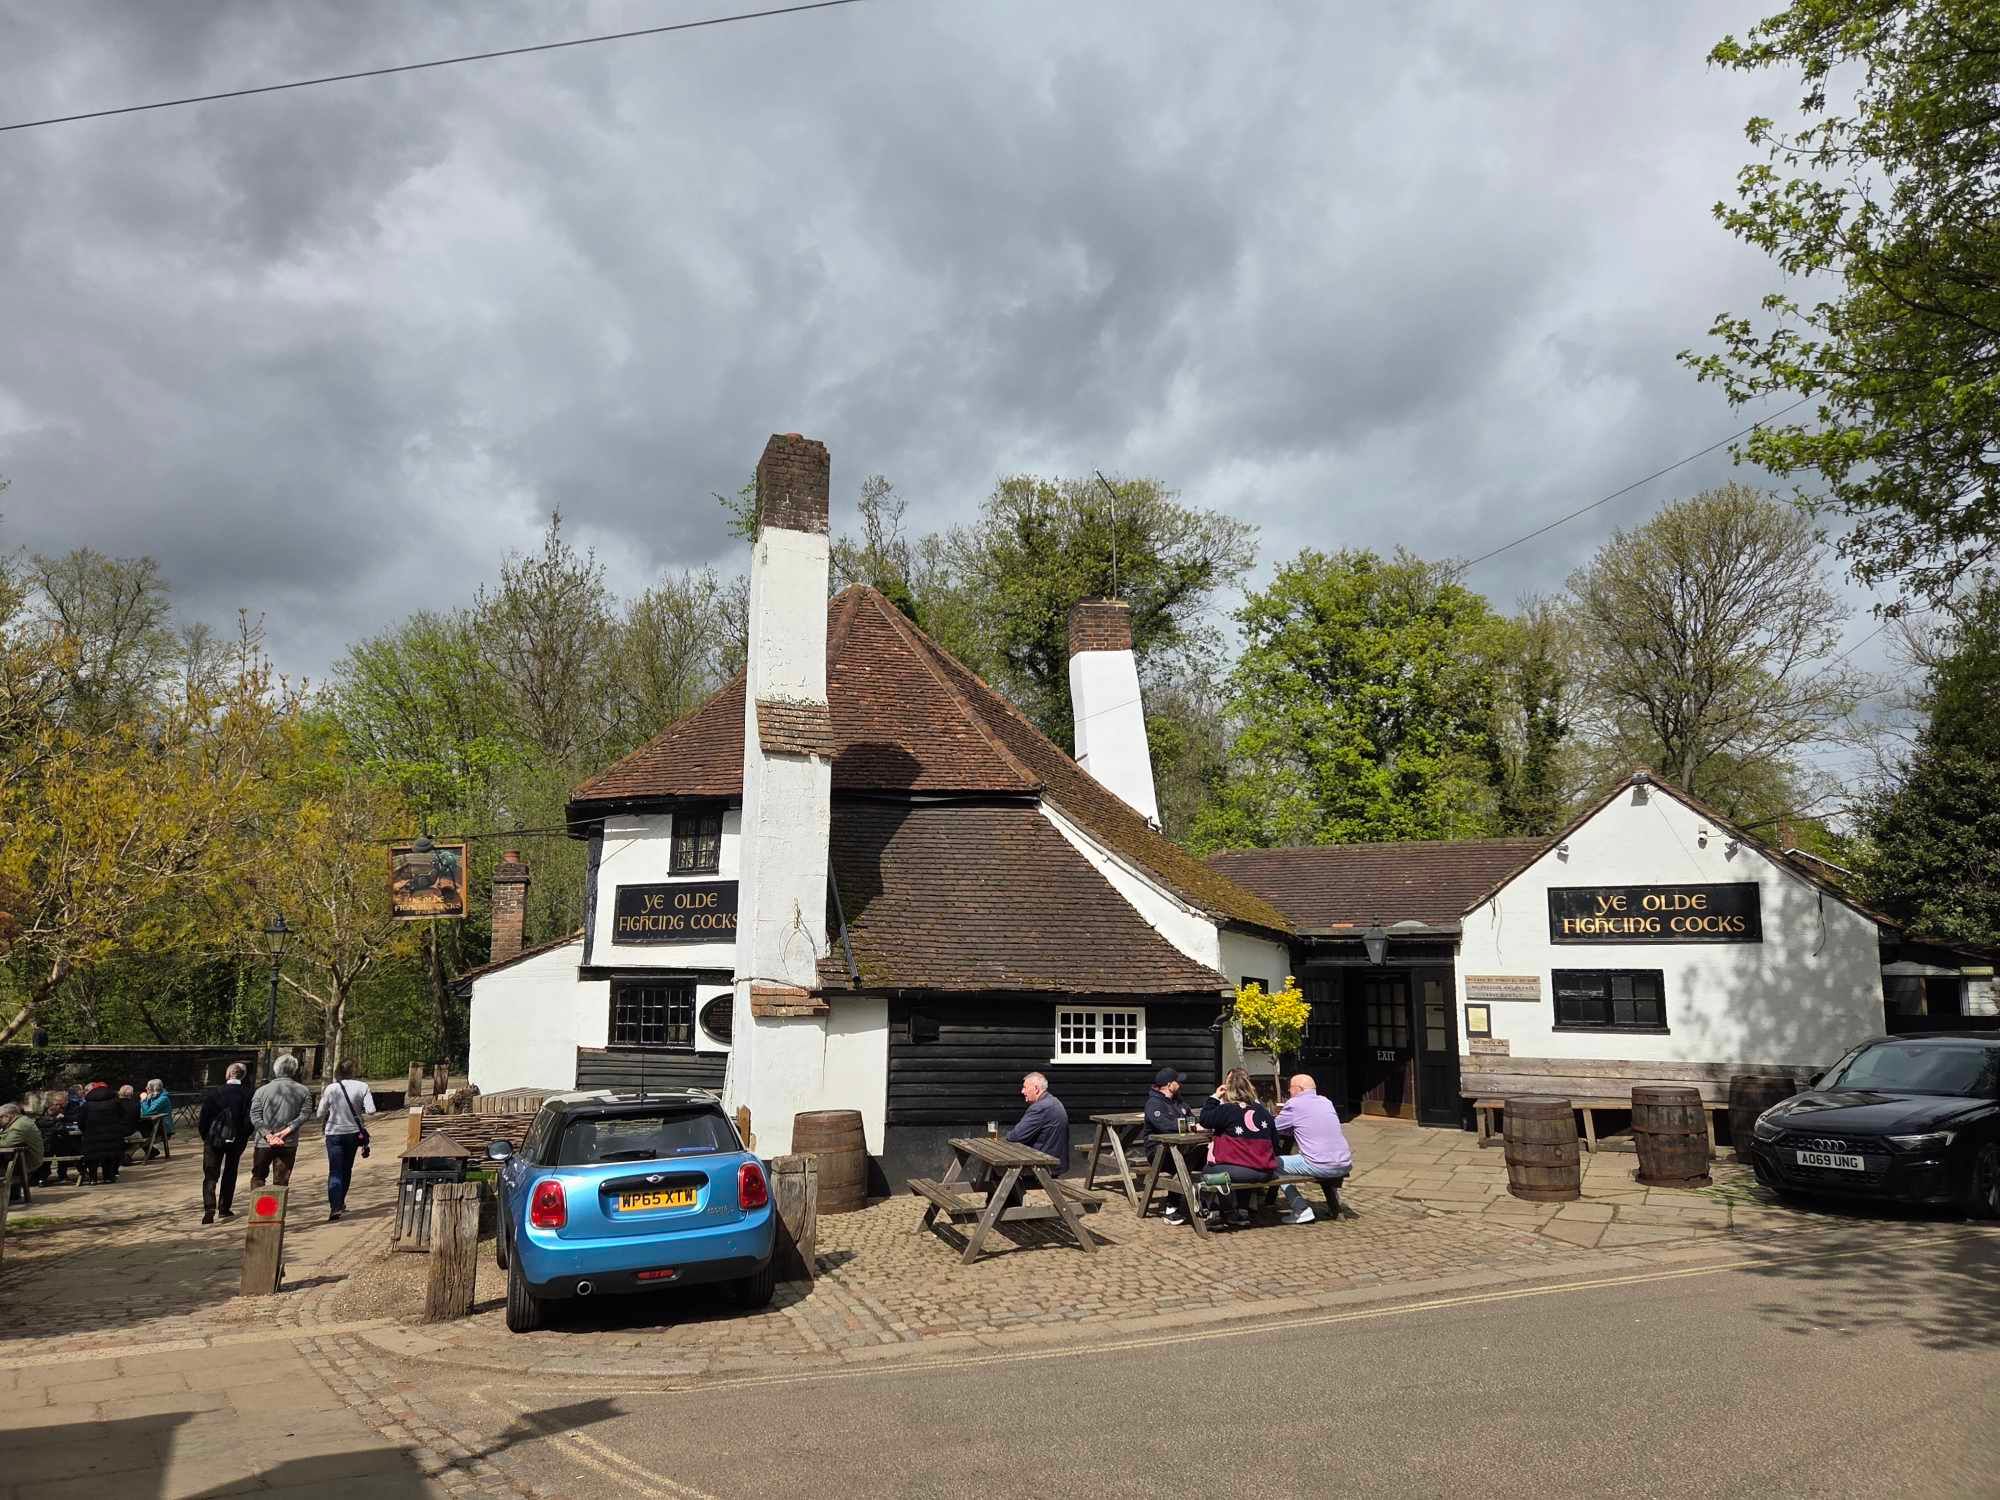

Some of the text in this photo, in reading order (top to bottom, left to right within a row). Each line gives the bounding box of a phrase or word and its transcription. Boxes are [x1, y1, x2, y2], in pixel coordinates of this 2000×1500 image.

[641, 892, 718, 913] YE OLDE
[1595, 894, 1708, 916] YE OLDE
[1670, 915, 1745, 933] COCKS
[1377, 1050, 1395, 1061] EXIT
[1801, 1152, 1858, 1168] AO69 UNG
[622, 1187, 694, 1209] WP65 XTW
